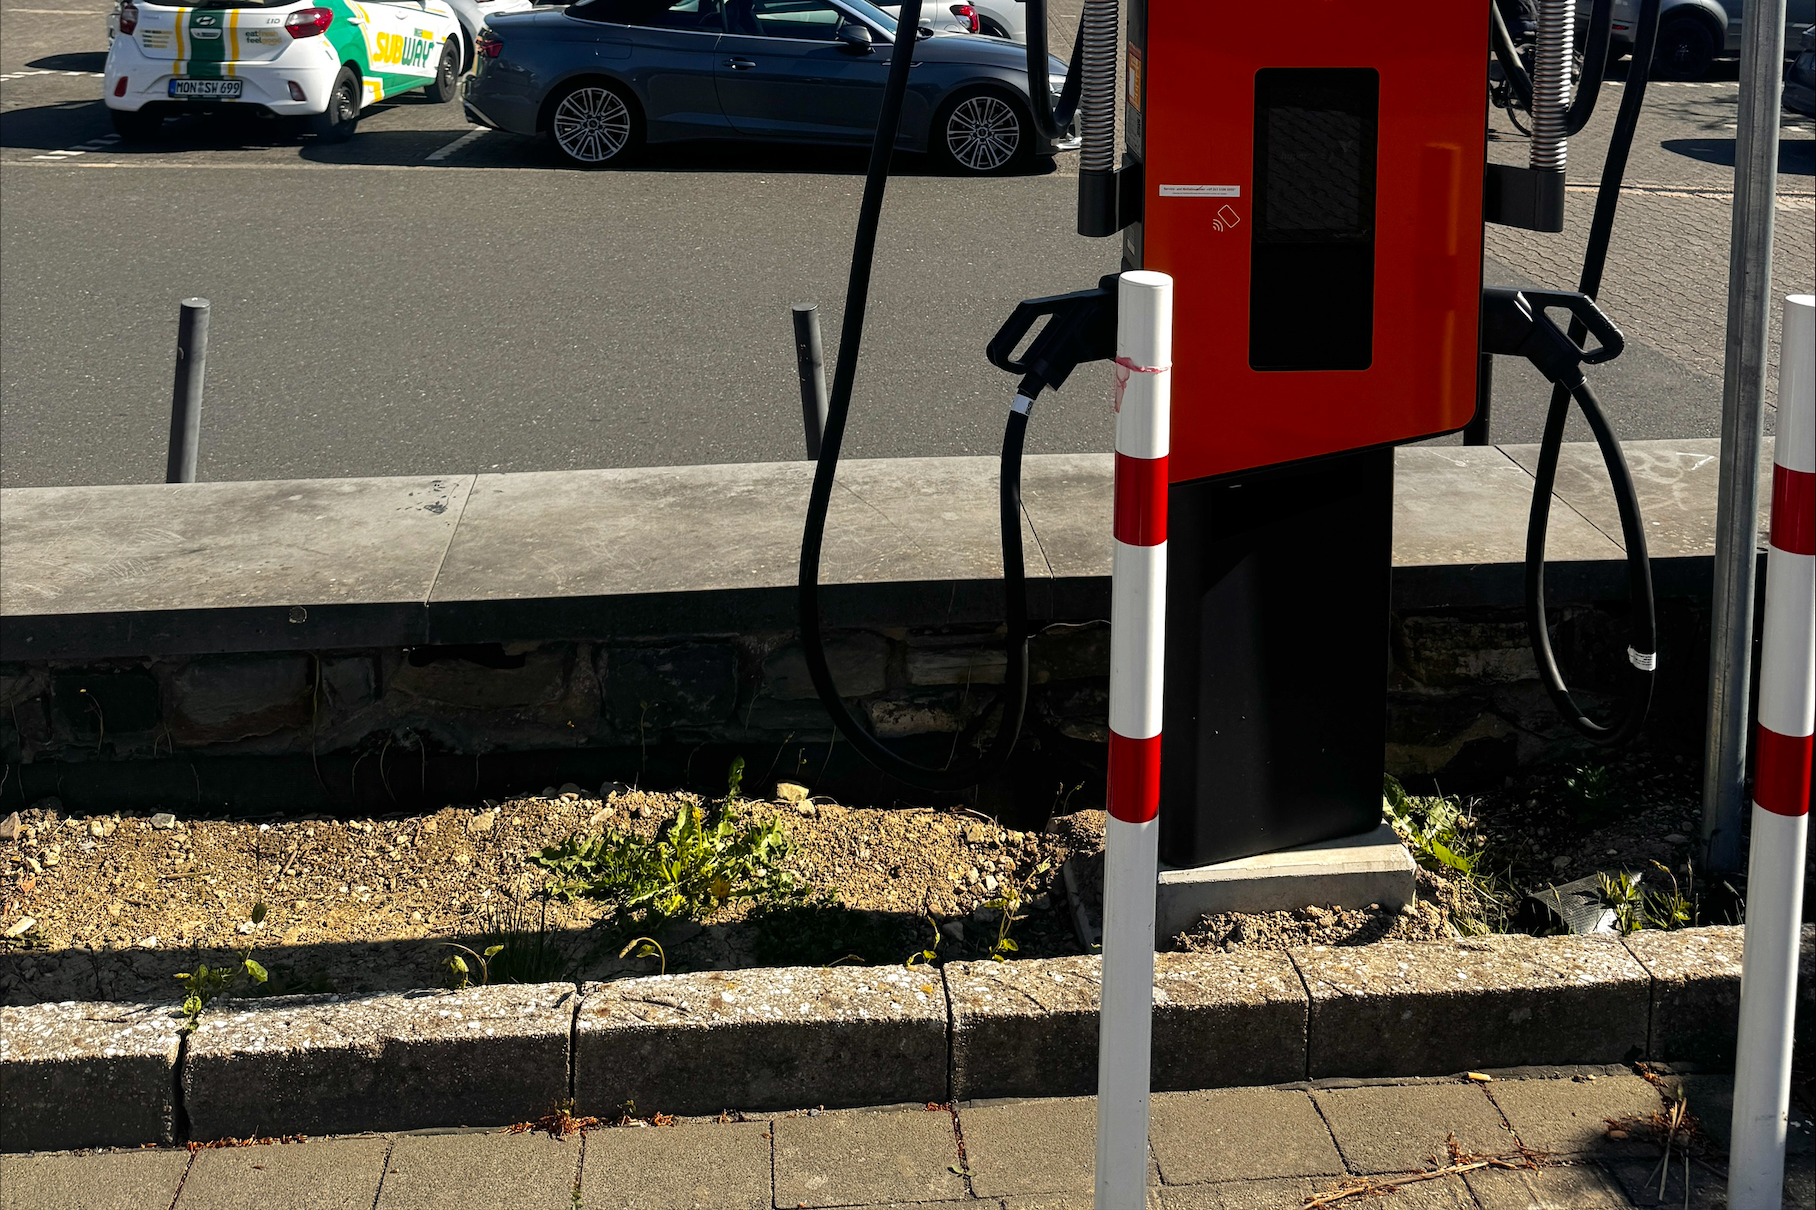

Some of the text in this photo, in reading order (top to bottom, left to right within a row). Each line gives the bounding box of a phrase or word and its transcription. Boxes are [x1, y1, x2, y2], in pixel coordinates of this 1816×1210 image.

[372, 31, 435, 68] SUBWAY
[176, 80, 240, 94] MON SW 699
